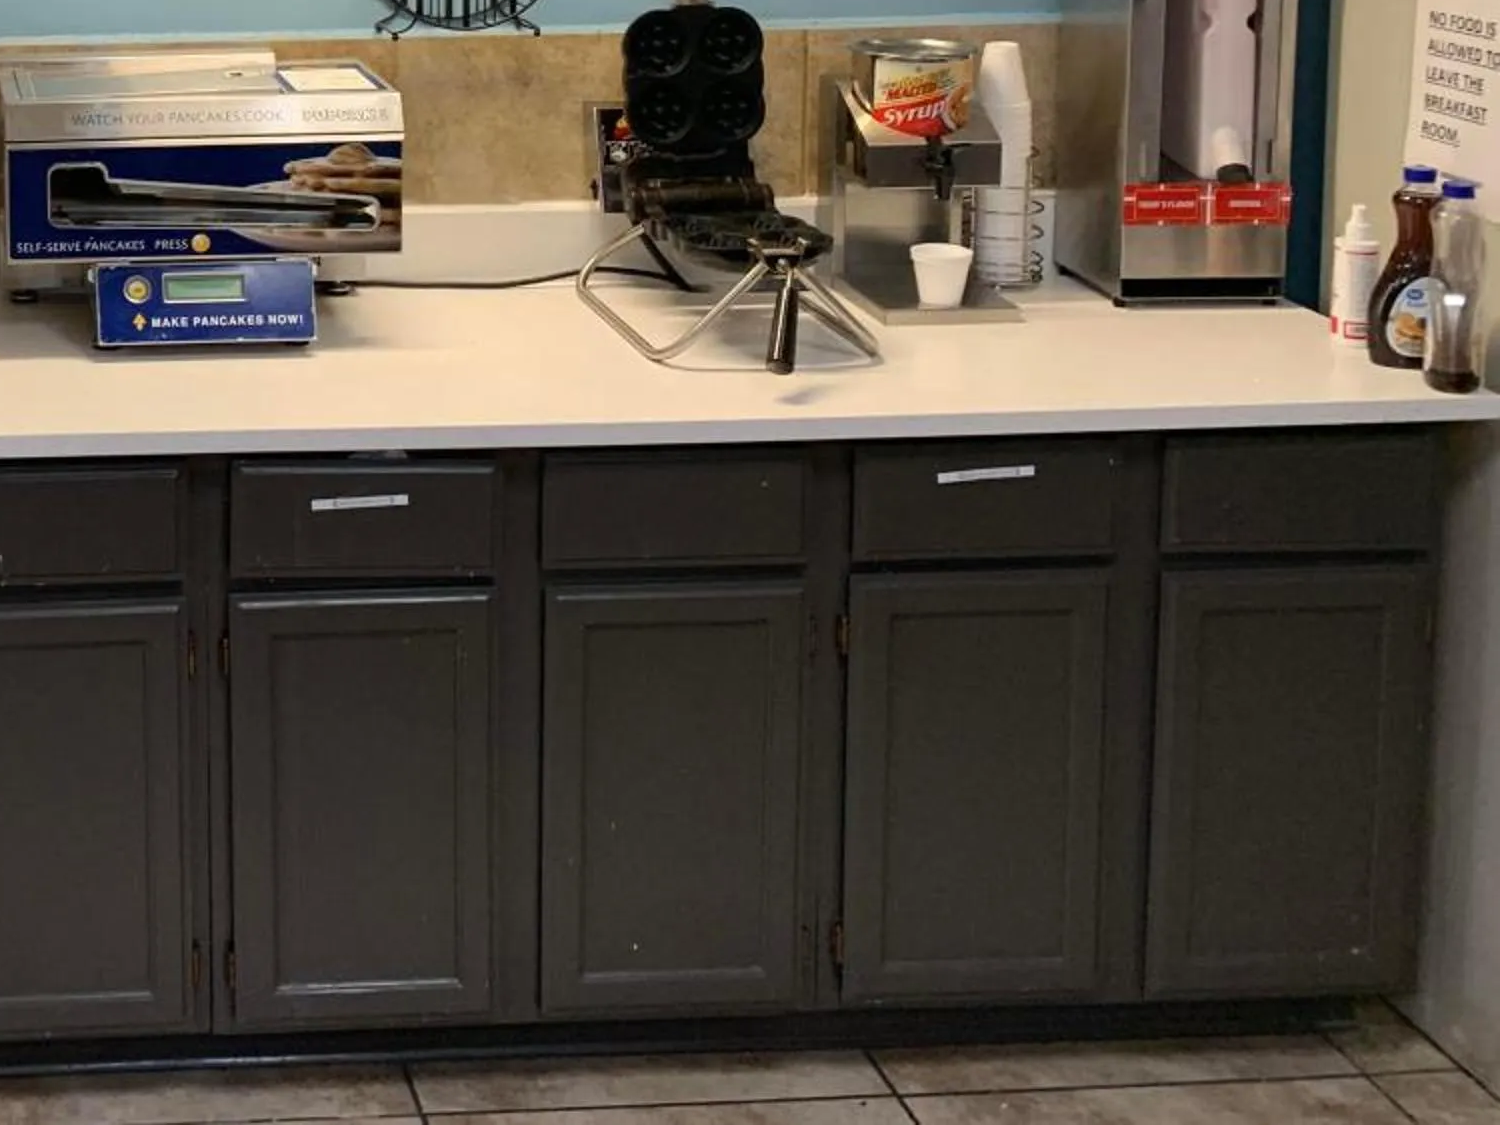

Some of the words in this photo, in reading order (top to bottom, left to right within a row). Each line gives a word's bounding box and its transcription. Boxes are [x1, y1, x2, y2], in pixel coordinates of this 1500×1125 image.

[1429, 11, 1447, 26] NO
[1450, 14, 1483, 34] FOOD
[1486, 21, 1497, 37] IS
[1428, 39, 1482, 62] ALLOWED
[1427, 66, 1460, 88] LEAVE
[1463, 74, 1485, 92] THE
[71, 112, 123, 126] WATCH
[127, 111, 165, 125] YOUR
[168, 109, 240, 124] PANCAKES
[883, 100, 945, 127] Syrup
[1425, 93, 1488, 121] BREAKFAST
[17, 240, 82, 254] SELF-SERVE
[84, 238, 145, 252] PANCAKES
[154, 238, 188, 251] PRESS
[151, 316, 189, 328] MAKE
[193, 314, 264, 327] PANCAKES
[267, 314, 304, 325] NOW!
